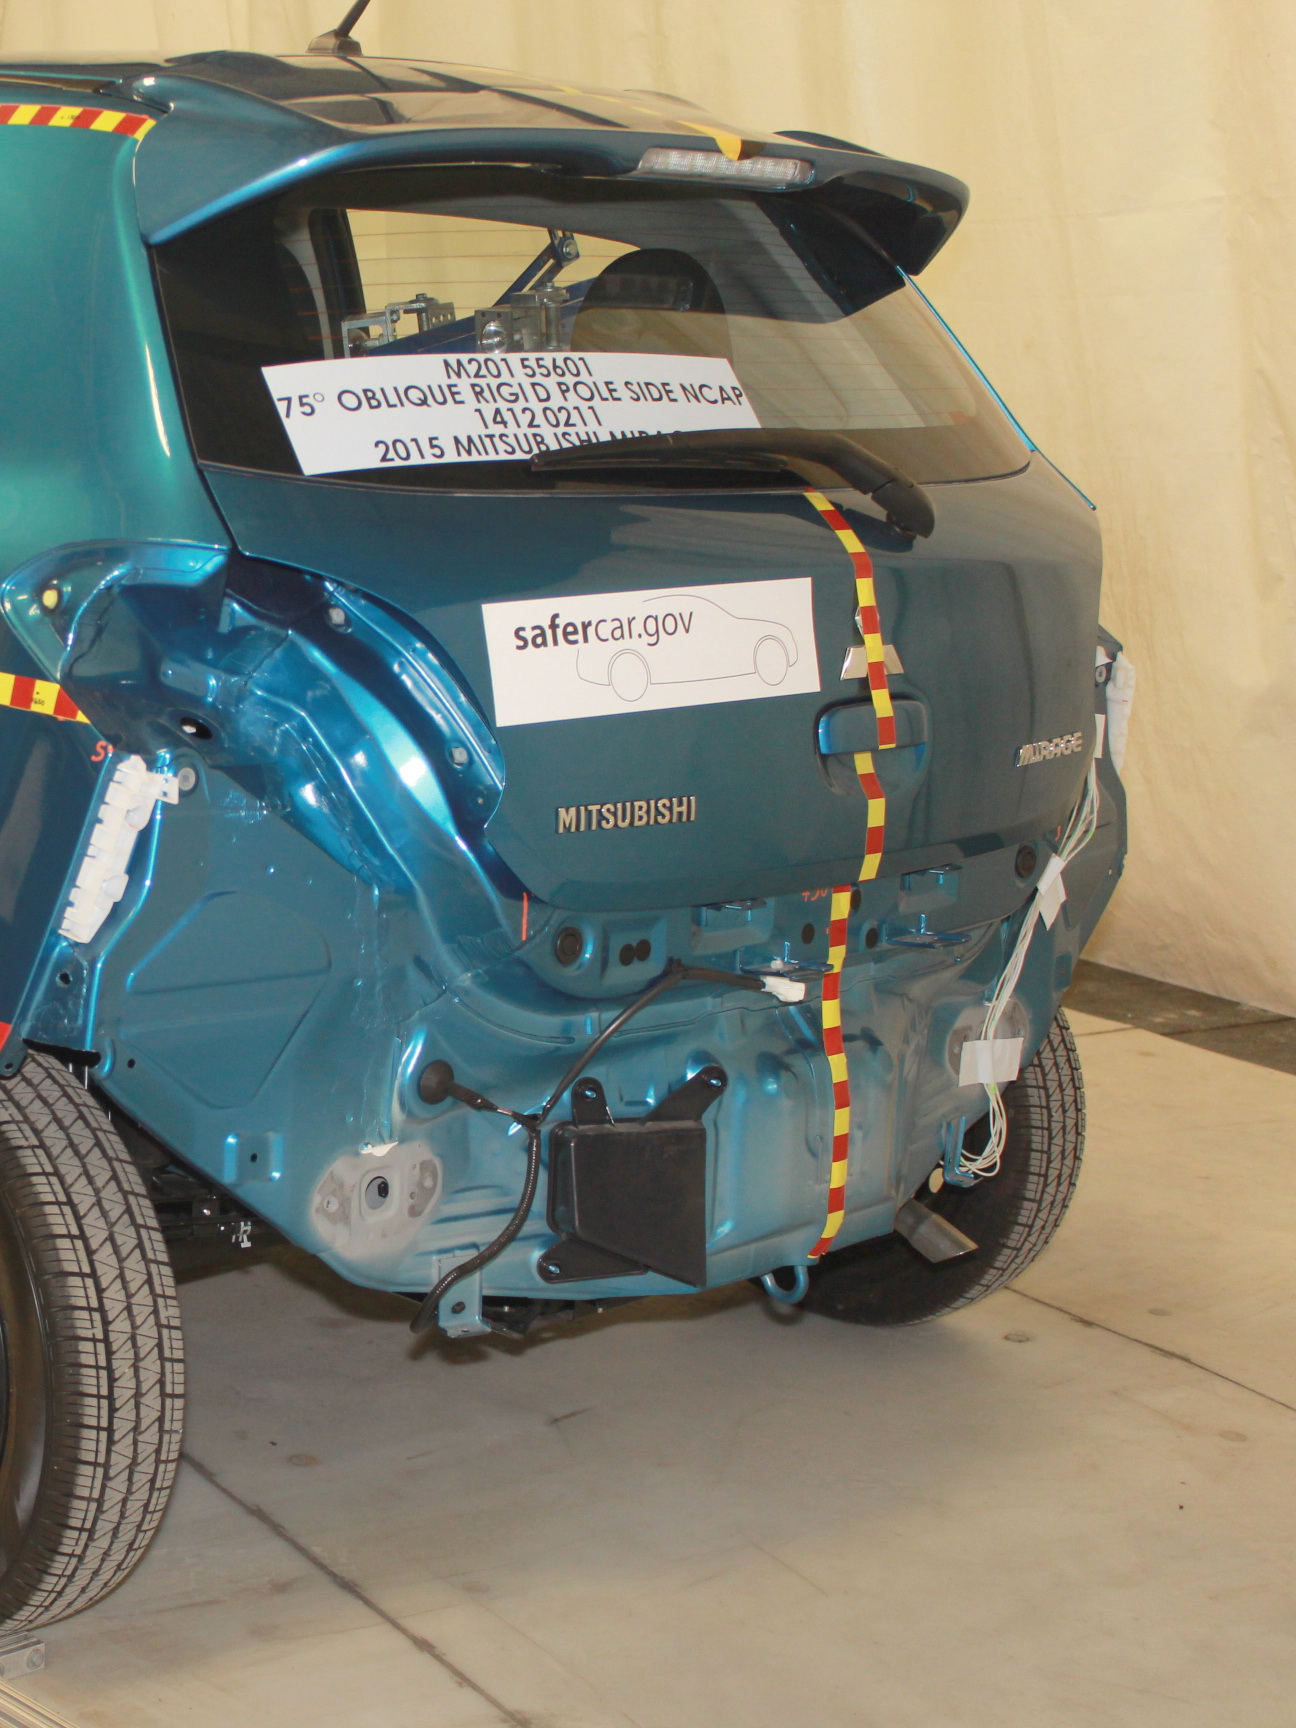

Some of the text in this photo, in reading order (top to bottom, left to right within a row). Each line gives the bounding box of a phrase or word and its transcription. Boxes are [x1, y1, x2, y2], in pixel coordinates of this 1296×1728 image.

[443, 356, 593, 379] M20155601
[337, 384, 465, 412] OBLIQUE
[470, 382, 551, 404] RIGID
[556, 381, 622, 402] POLE
[624, 381, 678, 402] SIDE
[679, 383, 743, 406] NCAP
[474, 406, 603, 430] 14120211
[374, 436, 445, 463] 2015
[513, 611, 694, 650] safercar.gov
[1015, 731, 1083, 768] MIRAGE
[557, 796, 696, 834] MITSUBISHI
